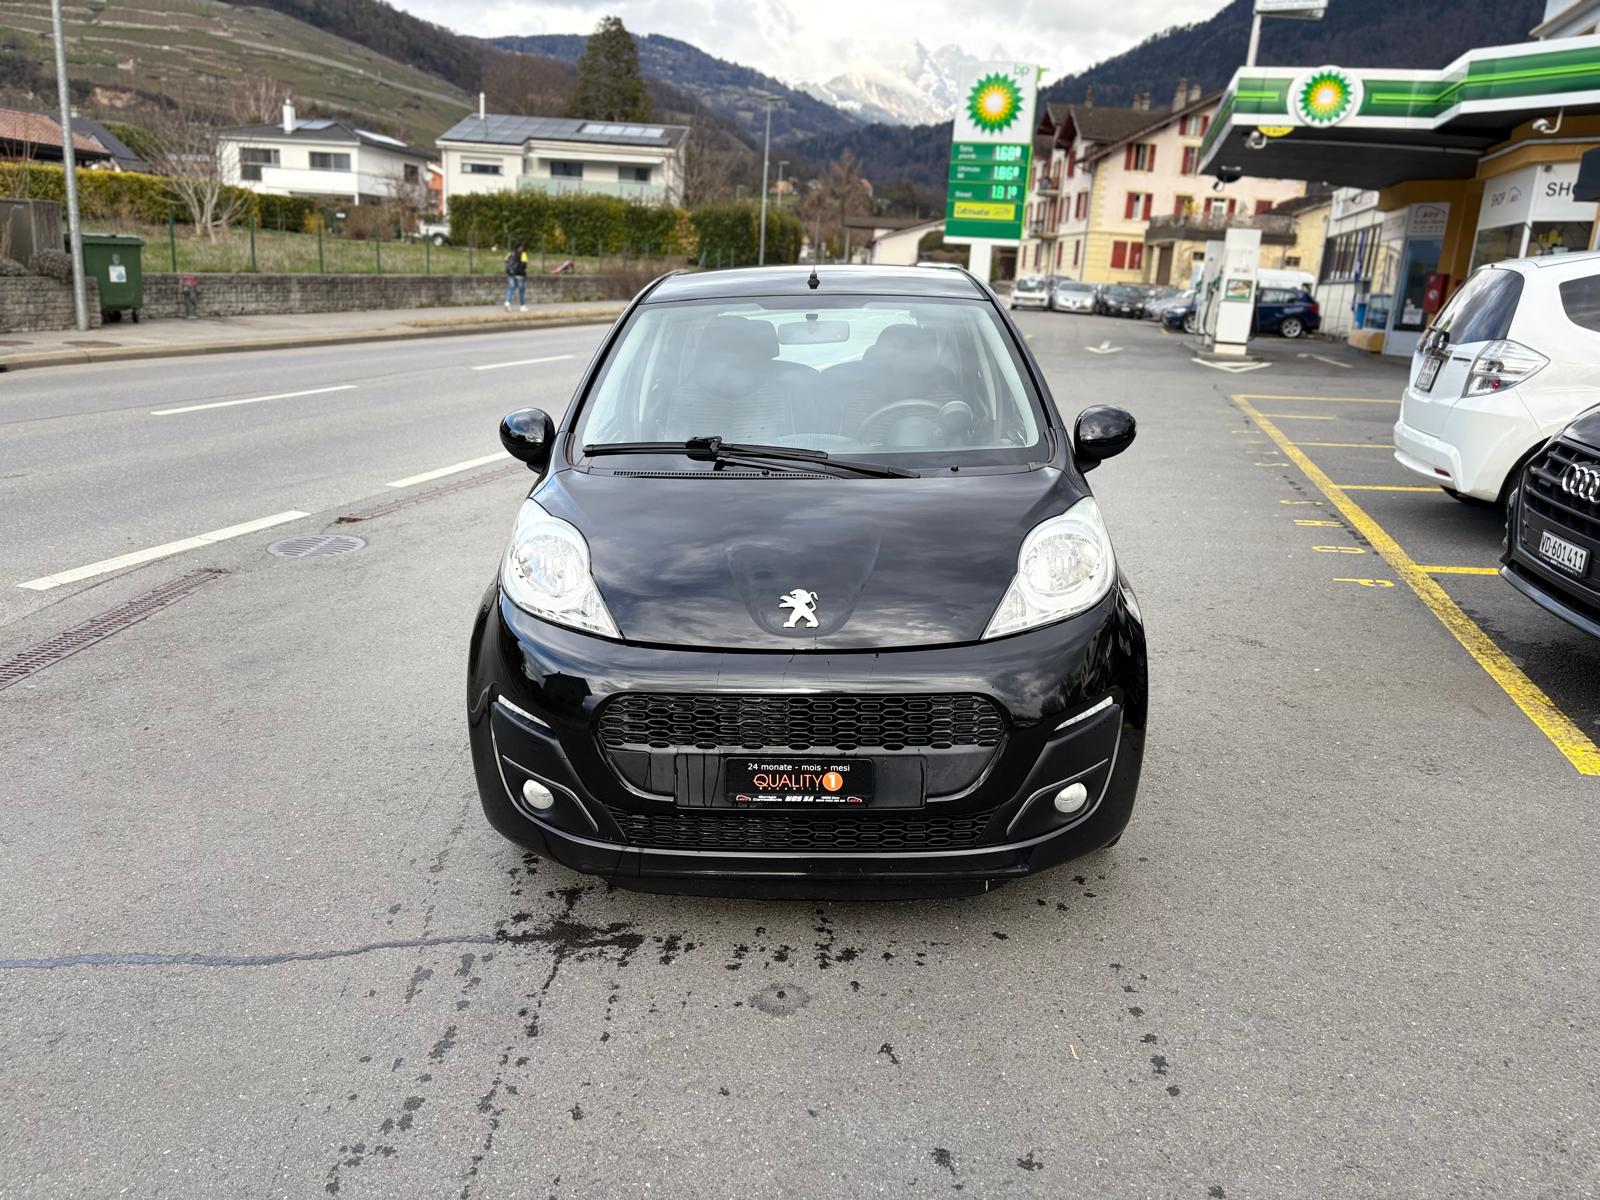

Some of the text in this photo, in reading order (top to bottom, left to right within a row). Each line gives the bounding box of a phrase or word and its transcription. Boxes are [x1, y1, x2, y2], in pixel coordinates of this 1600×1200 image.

[1545, 182, 1575, 197] SH
[748, 762, 759, 771] 24
[761, 763, 793, 771] monate
[801, 763, 822, 772] mois
[830, 763, 850, 772] mesi
[753, 773, 823, 788] QUALITY
